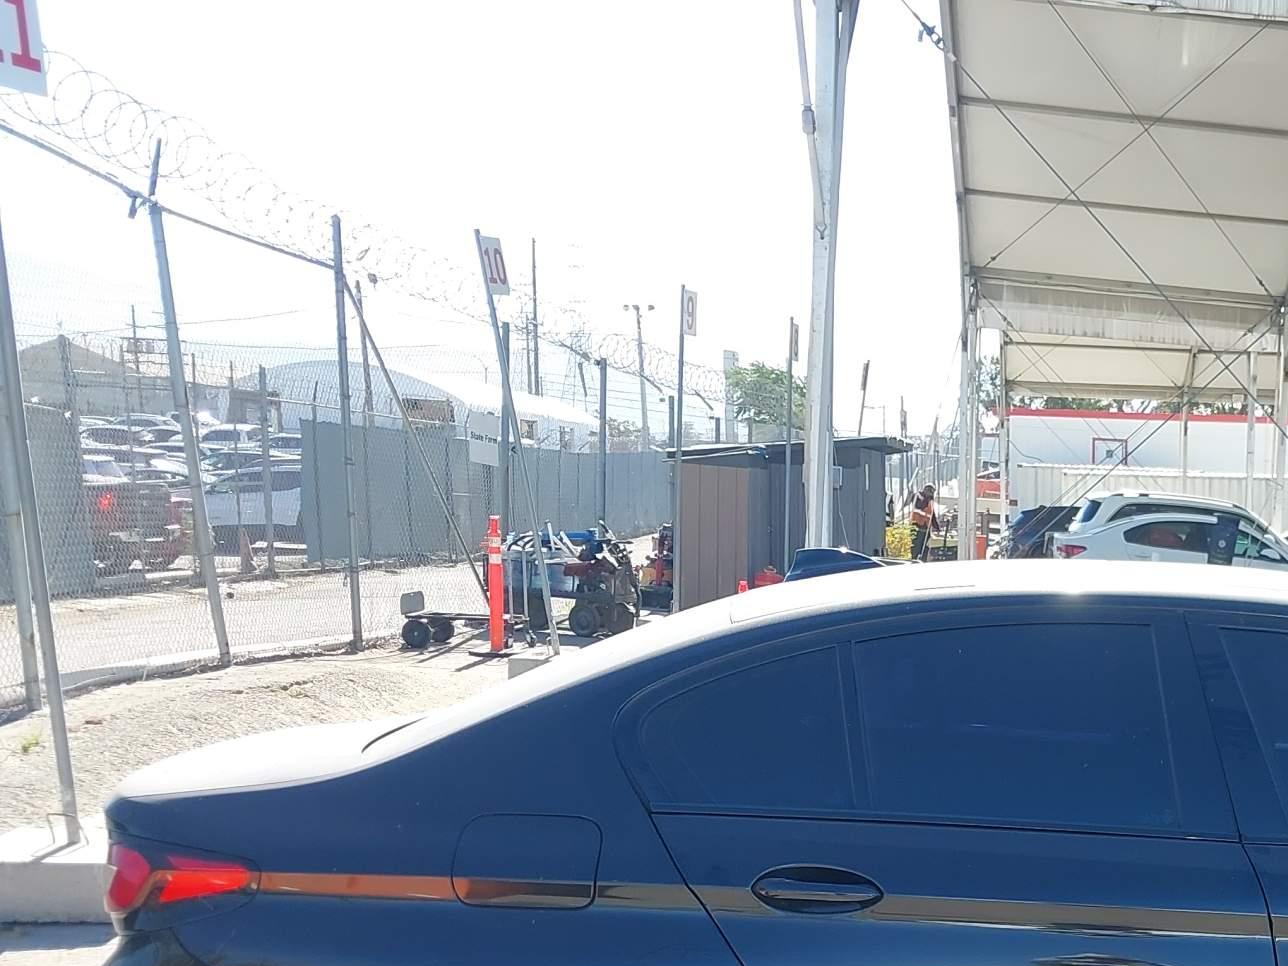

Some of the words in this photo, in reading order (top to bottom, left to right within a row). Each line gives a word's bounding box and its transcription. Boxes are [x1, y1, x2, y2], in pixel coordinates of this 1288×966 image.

[0, 0, 42, 73] 1
[484, 247, 507, 285] 10
[687, 296, 694, 330] 9
[793, 328, 799, 357] 8
[470, 431, 484, 442] State
[485, 434, 498, 445] Farm
